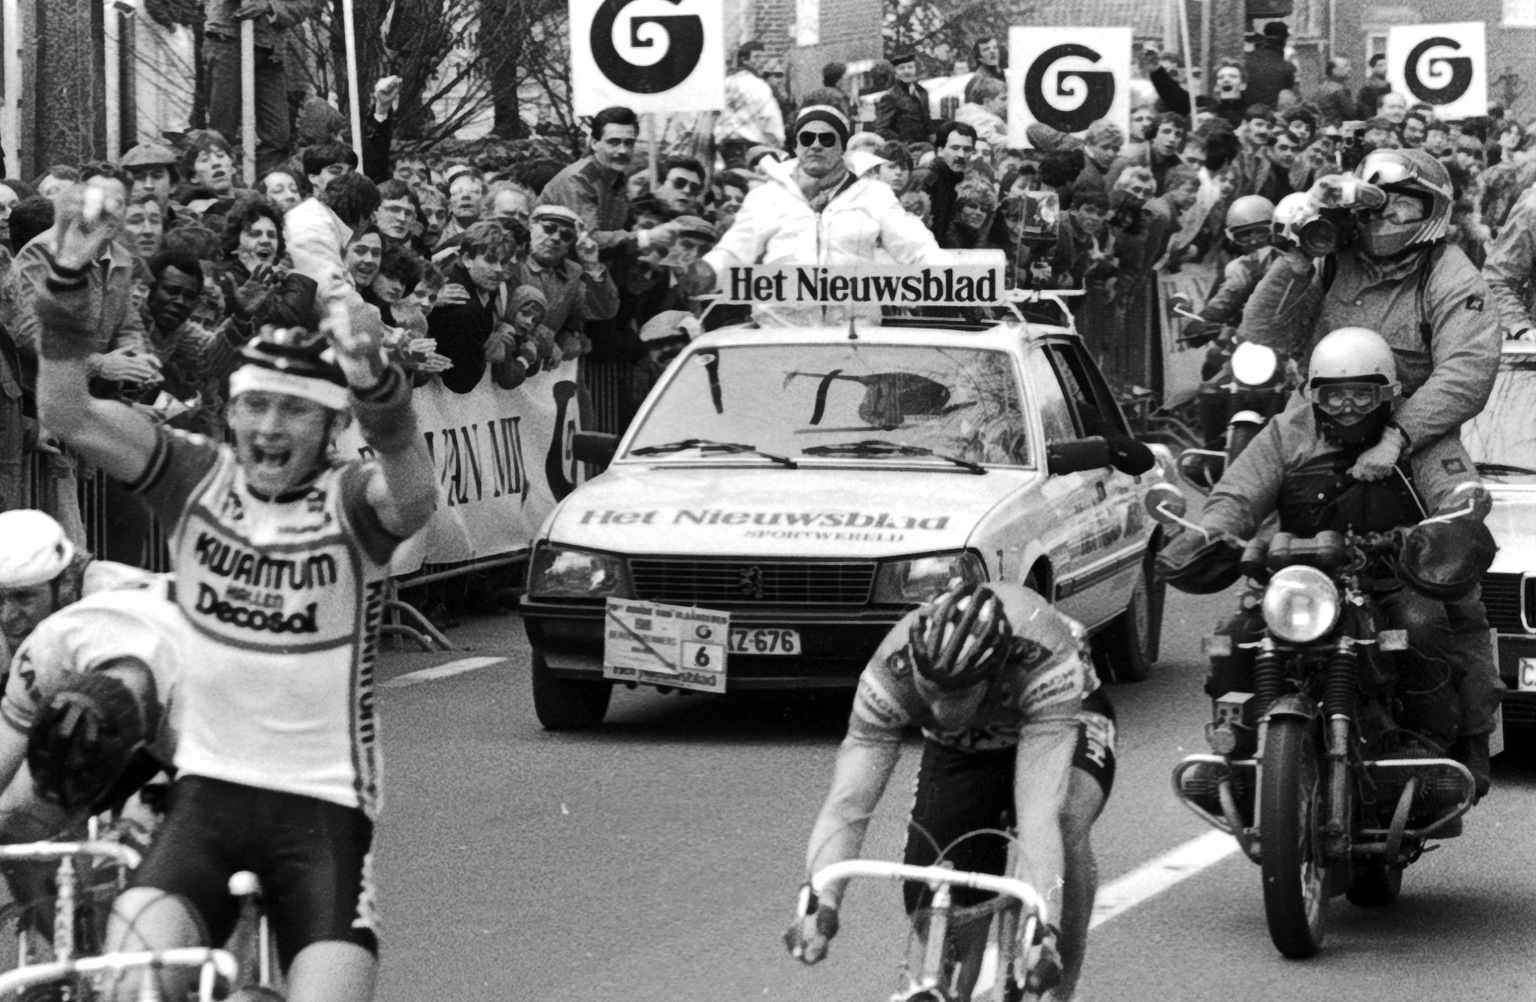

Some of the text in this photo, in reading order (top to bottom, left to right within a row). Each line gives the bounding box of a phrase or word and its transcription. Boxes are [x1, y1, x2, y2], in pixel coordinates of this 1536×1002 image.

[589, 0, 704, 94] G
[1404, 36, 1473, 105] G
[1024, 43, 1116, 133] G
[729, 266, 999, 303] Het Nieuwsblad
[579, 509, 952, 531] Het Nieuwsblad
[195, 531, 338, 591] KWANTUM
[694, 645, 711, 668] 6
